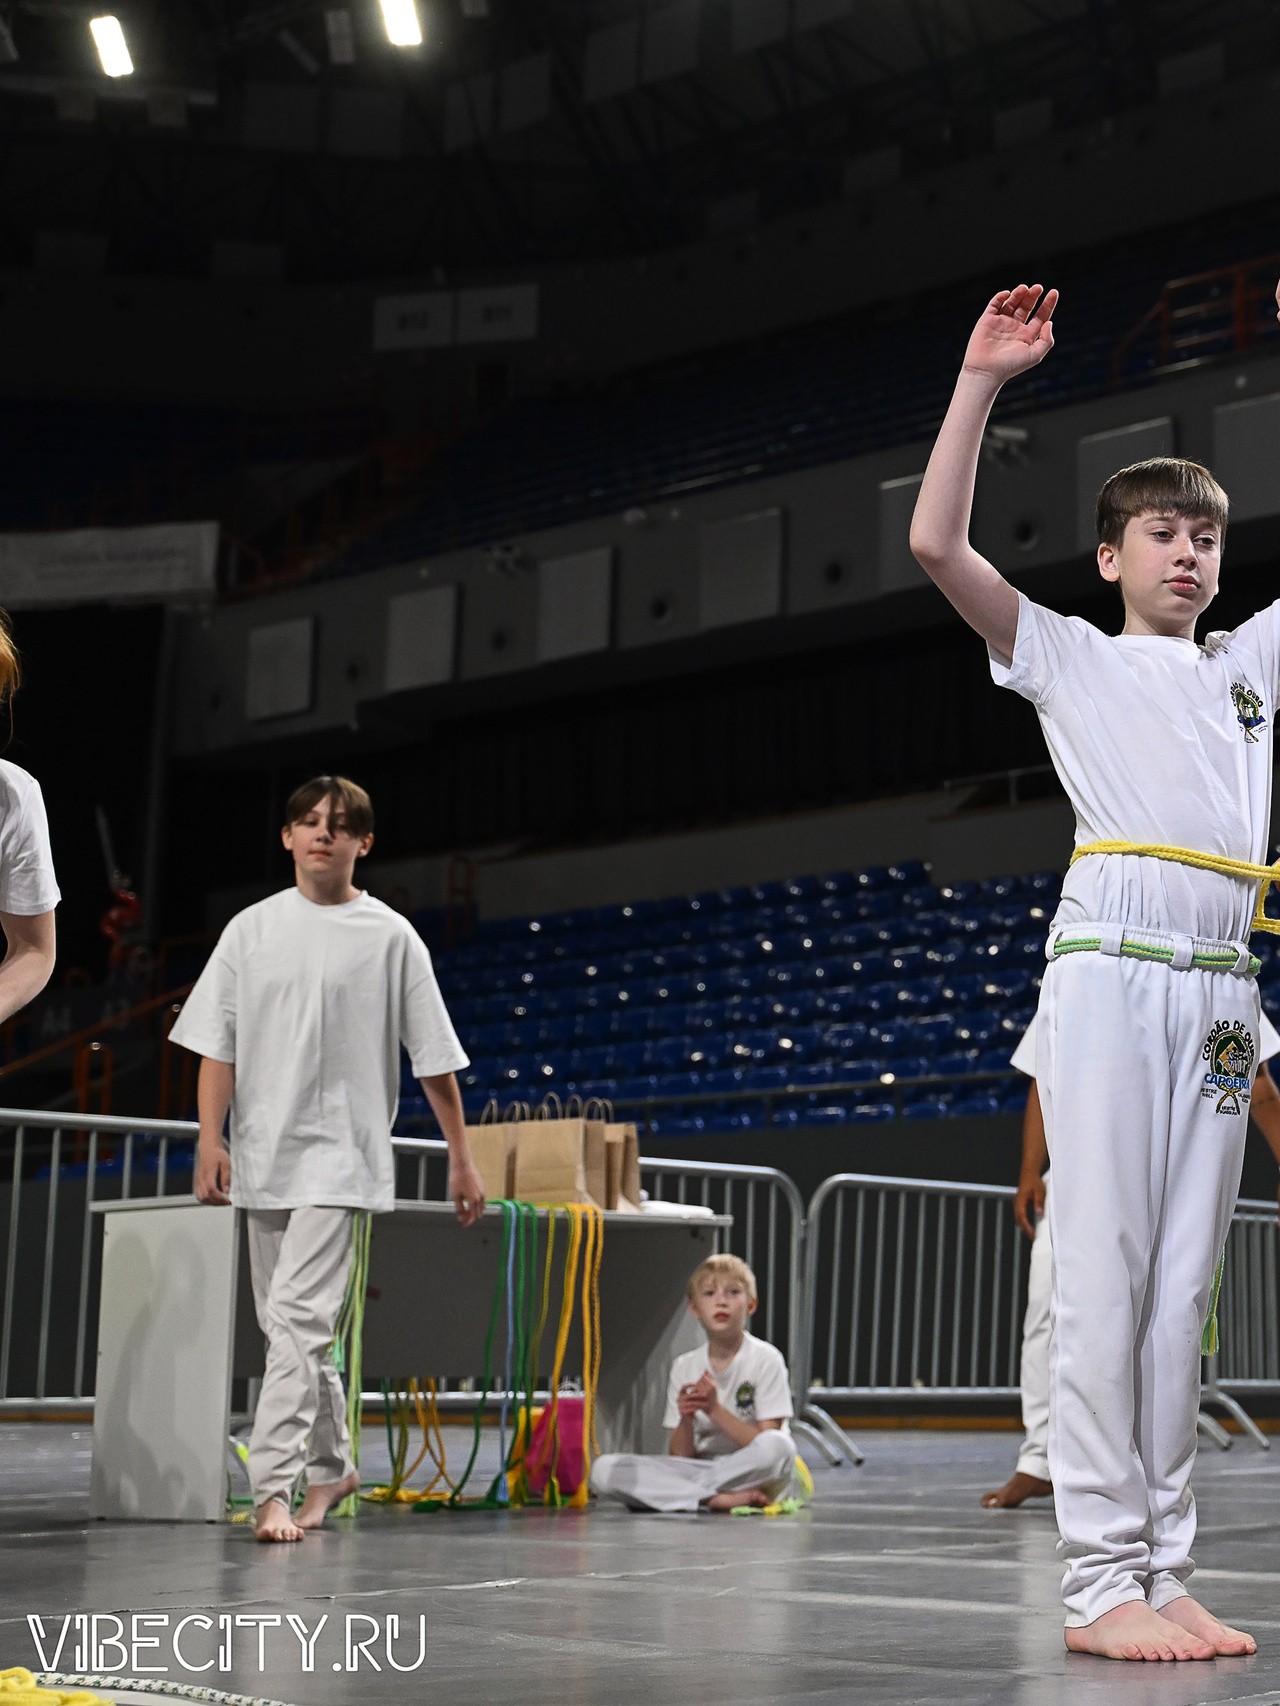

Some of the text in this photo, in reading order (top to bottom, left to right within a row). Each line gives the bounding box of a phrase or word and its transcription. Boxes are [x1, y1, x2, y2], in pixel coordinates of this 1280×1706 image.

[1246, 689, 1263, 707] OURO
[1202, 1020, 1230, 1061] CORDÃO
[1233, 1020, 1246, 1034] DE
[1204, 1073, 1250, 1090] CAPOEIRA
